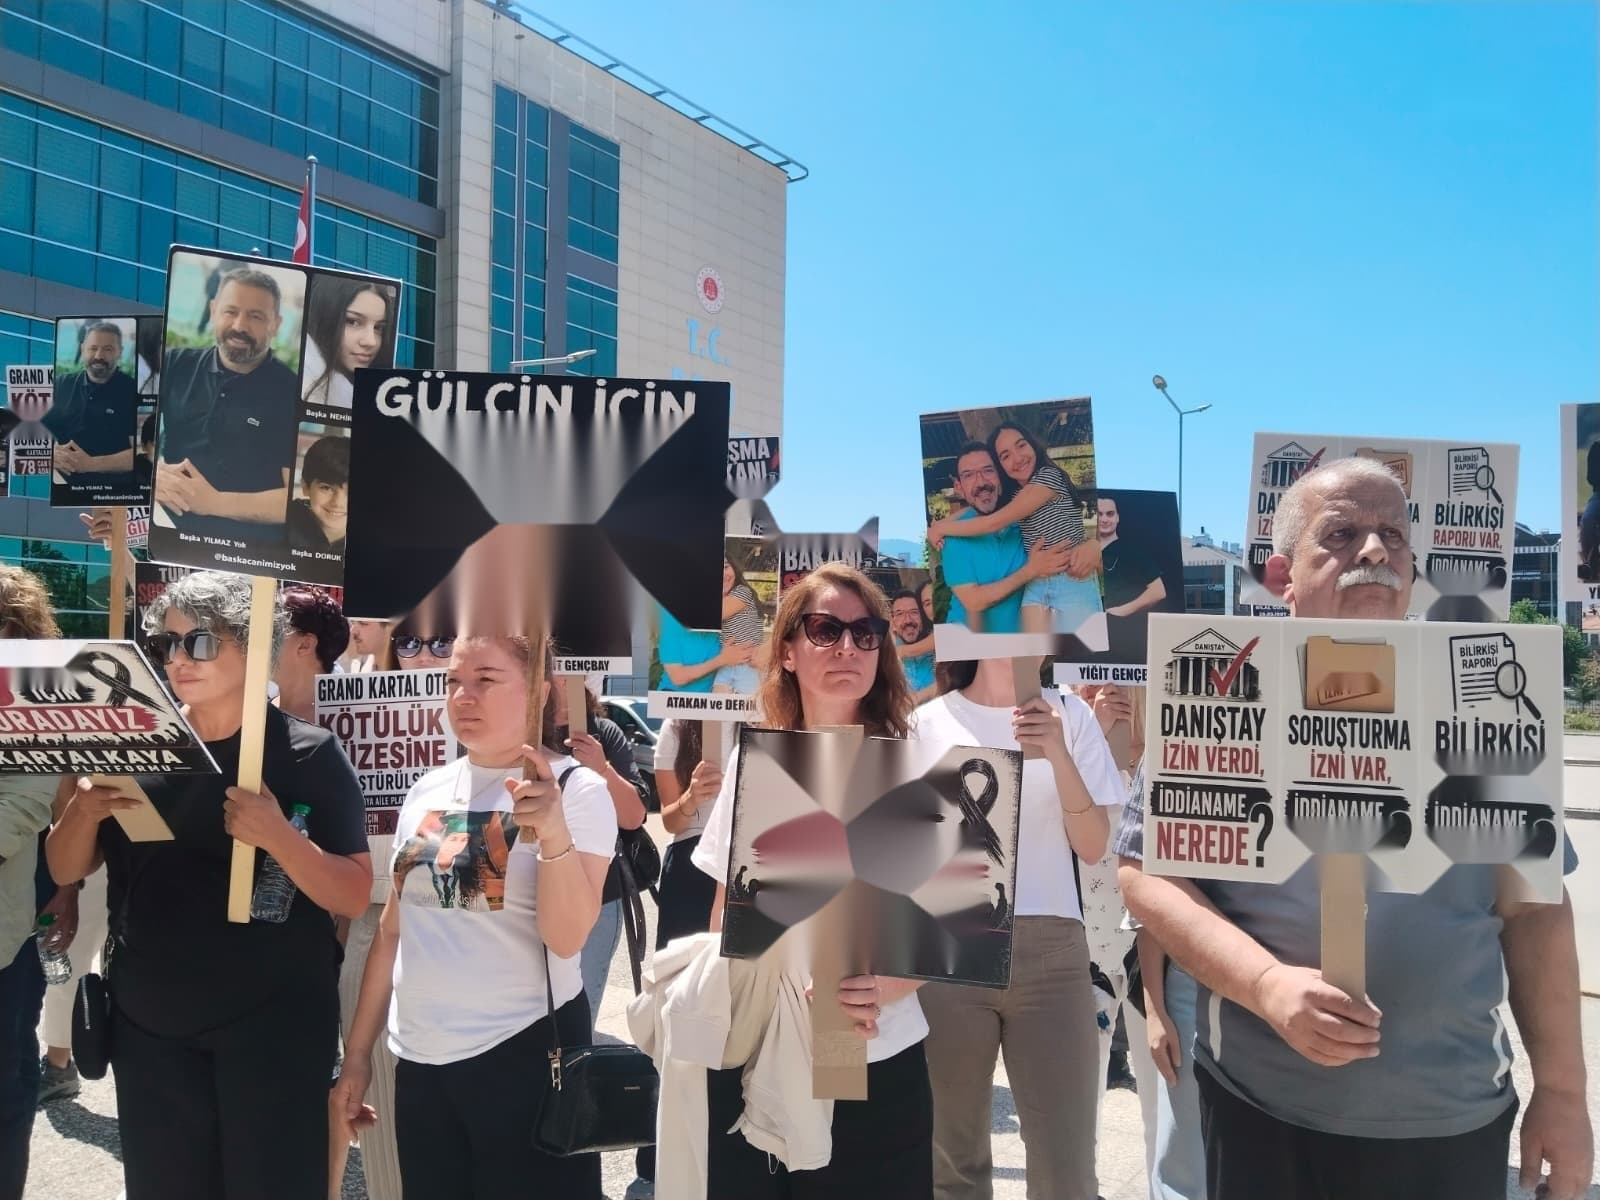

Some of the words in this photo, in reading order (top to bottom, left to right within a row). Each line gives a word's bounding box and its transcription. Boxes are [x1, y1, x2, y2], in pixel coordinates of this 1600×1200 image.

[9, 369, 44, 385] GRAND
[20, 461, 36, 474] 78
[1435, 501, 1504, 528] BİLİRKİŞİ
[1433, 530, 1477, 547] RAPORU
[315, 552, 342, 561] DORUK
[1459, 643, 1499, 658] BİLİRKİŞİ
[565, 660, 609, 674] GENÇBAY
[1462, 656, 1498, 669] RAPORU
[1079, 665, 1109, 681] YİĞİT
[318, 677, 363, 701] GRAND
[369, 675, 421, 699] KARTAL
[667, 696, 707, 709] ATAKAN
[710, 700, 722, 710] ve
[319, 703, 444, 740] KÖTÜLÜK
[1161, 703, 1266, 744] DANIŞTAY
[1288, 714, 1411, 754] SORUŞTURMA
[1163, 739, 1199, 771] İZİN
[1206, 743, 1265, 778] VERDİ,
[1311, 749, 1346, 779] İZNİ
[1351, 755, 1392, 784] VAR,
[1159, 782, 1248, 818] İDDİANAME
